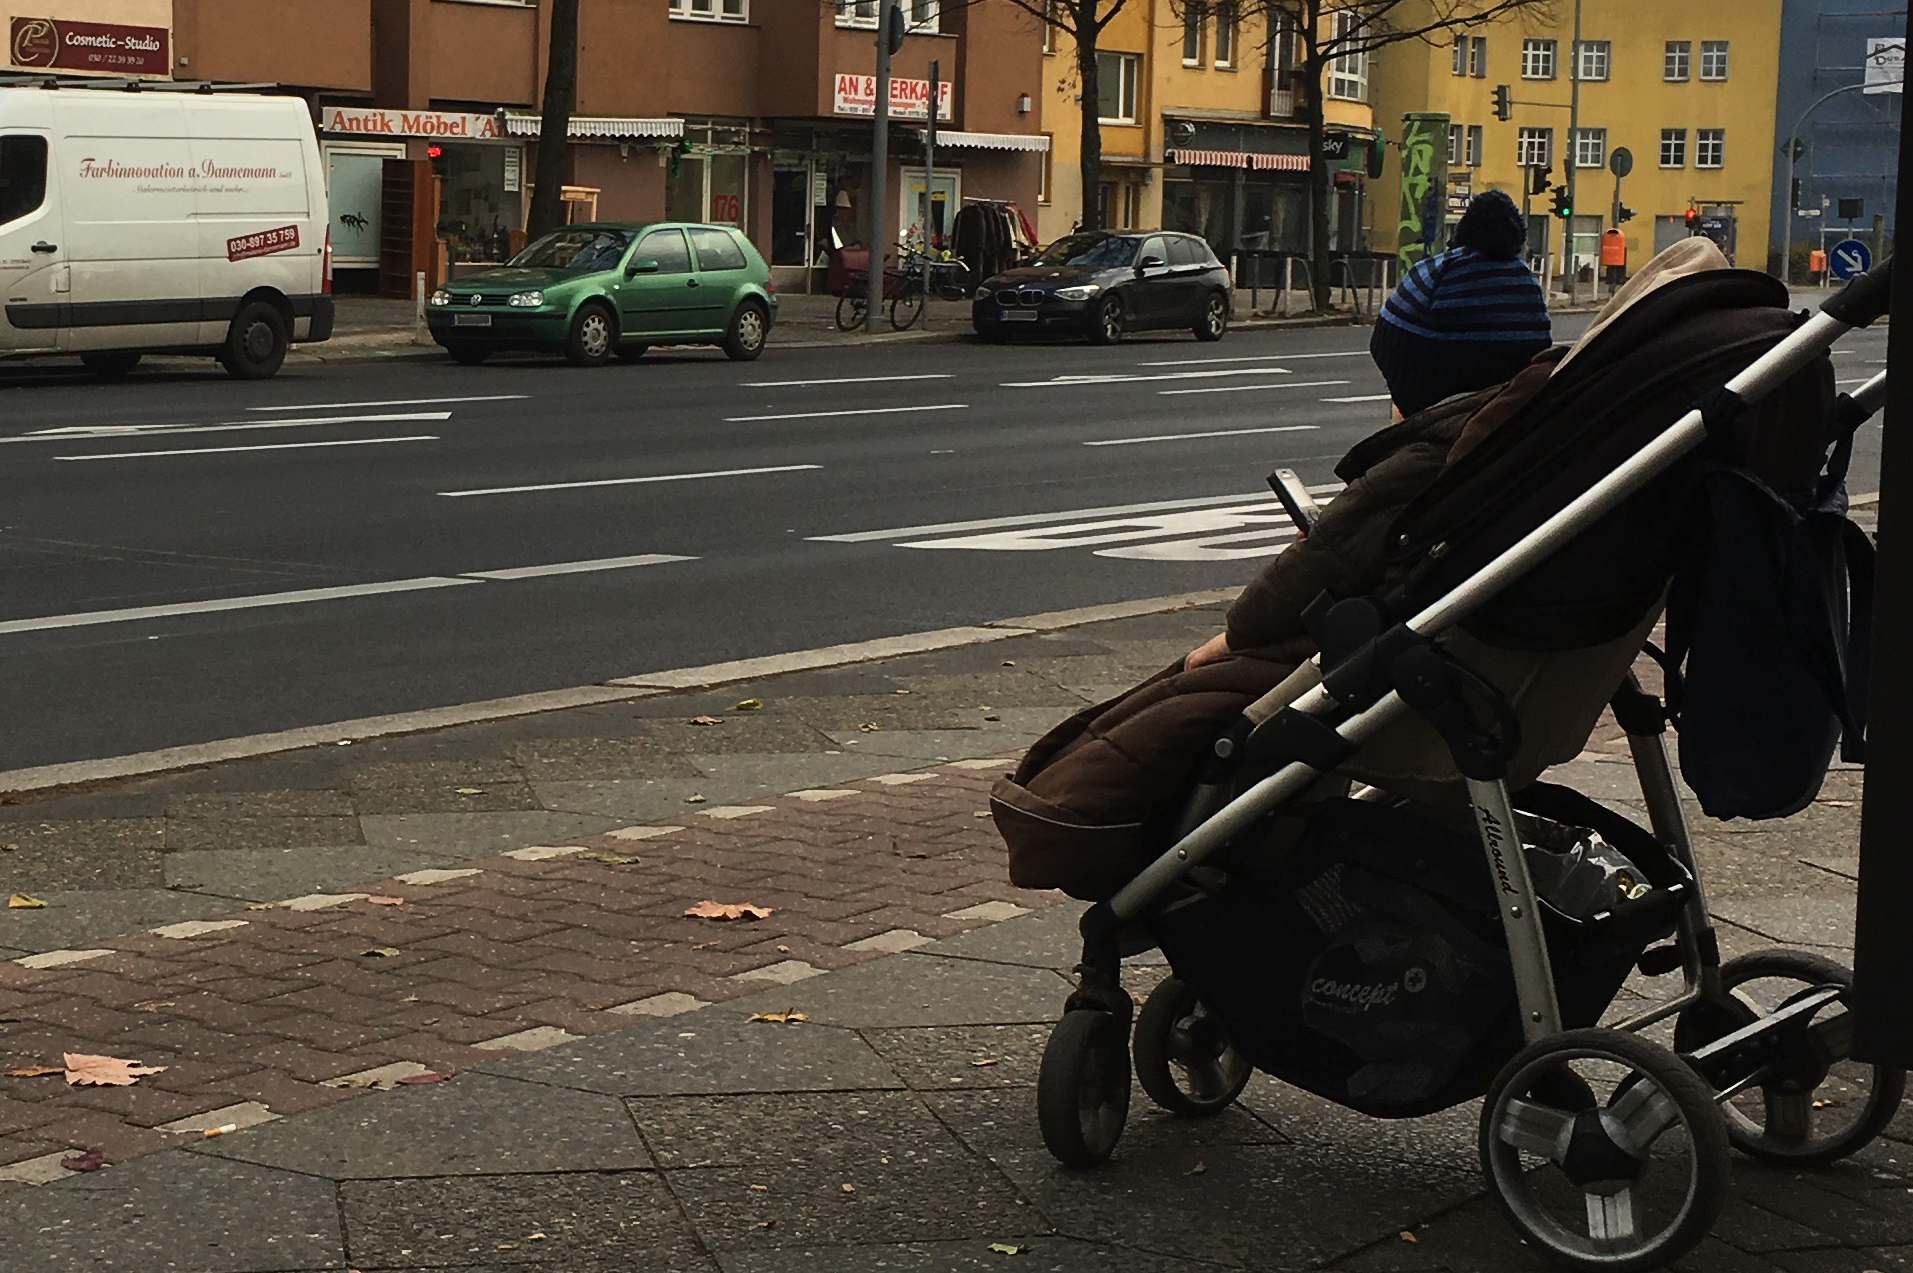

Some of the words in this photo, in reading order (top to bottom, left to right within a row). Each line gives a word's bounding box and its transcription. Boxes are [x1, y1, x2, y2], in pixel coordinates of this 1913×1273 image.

[837, 75, 859, 96] AN
[864, 77, 874, 97] &
[889, 79, 949, 102] ERKAF
[330, 110, 394, 133] Antik
[400, 112, 468, 136] Möbel
[1322, 138, 1343, 154] sky
[79, 157, 184, 179] Farbinnovation
[713, 194, 739, 222] 176
[230, 234, 265, 252] 030-897
[266, 231, 278, 244] 35
[279, 228, 295, 242] 759
[1478, 806, 1519, 895] Allround
[1311, 977, 1399, 1012] concept
